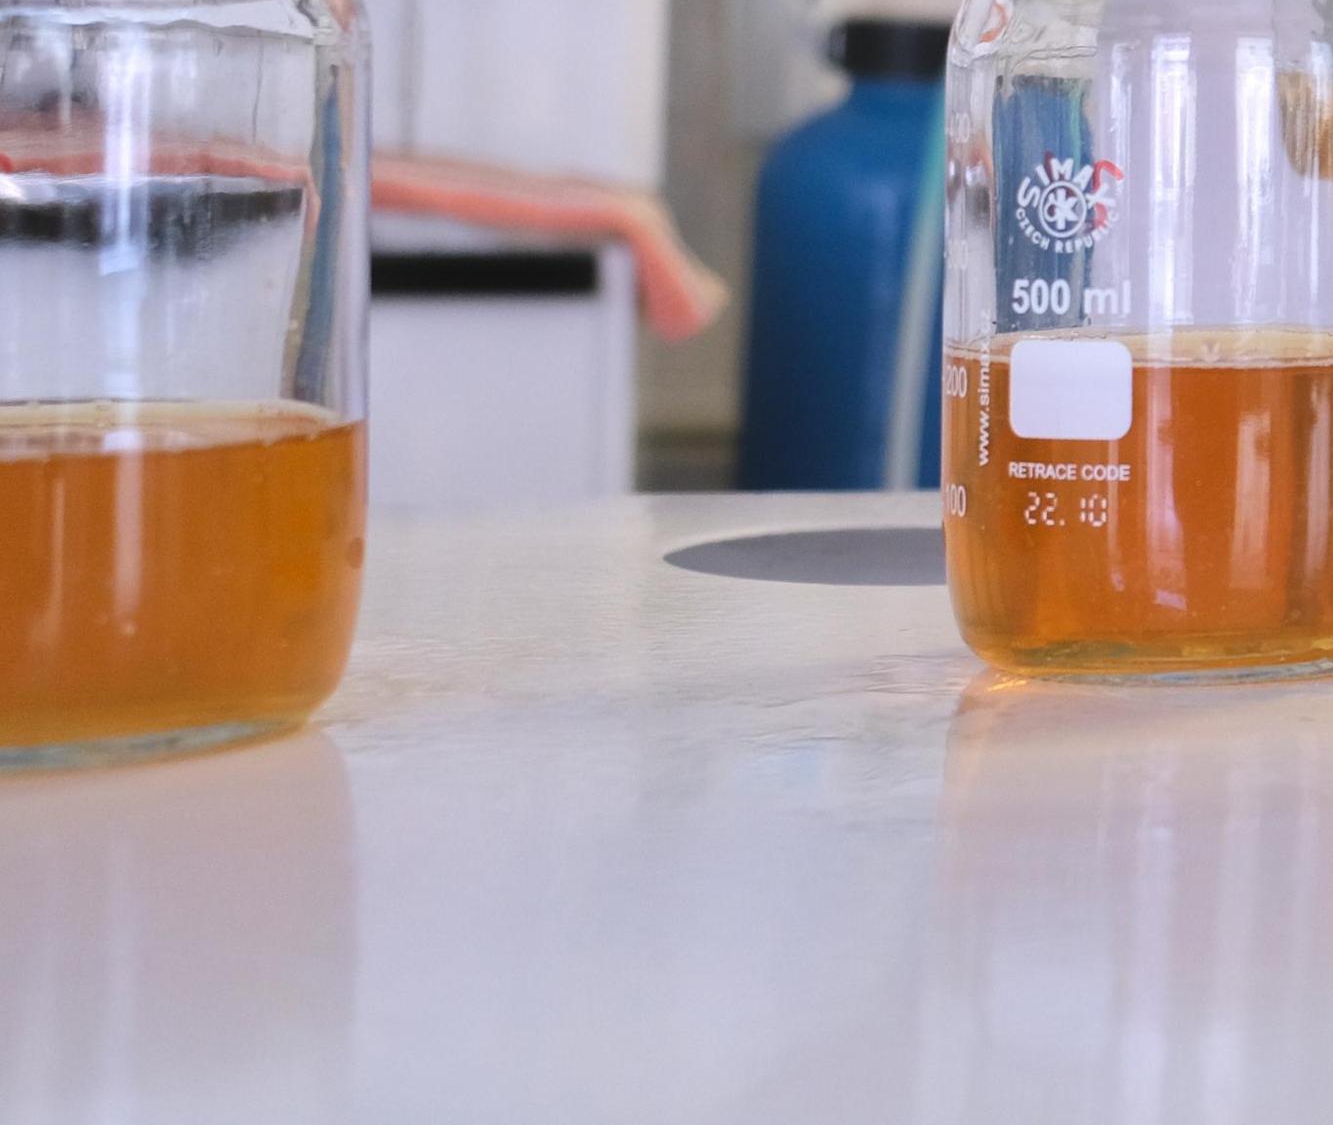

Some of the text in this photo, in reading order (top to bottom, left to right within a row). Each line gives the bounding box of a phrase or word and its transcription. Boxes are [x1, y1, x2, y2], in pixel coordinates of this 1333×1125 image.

[1017, 158, 1117, 210] SIMAX
[1015, 206, 1051, 251] CZECH
[1011, 278, 1132, 315] 500 ml
[1008, 461, 1131, 482] RETRACE CODE
